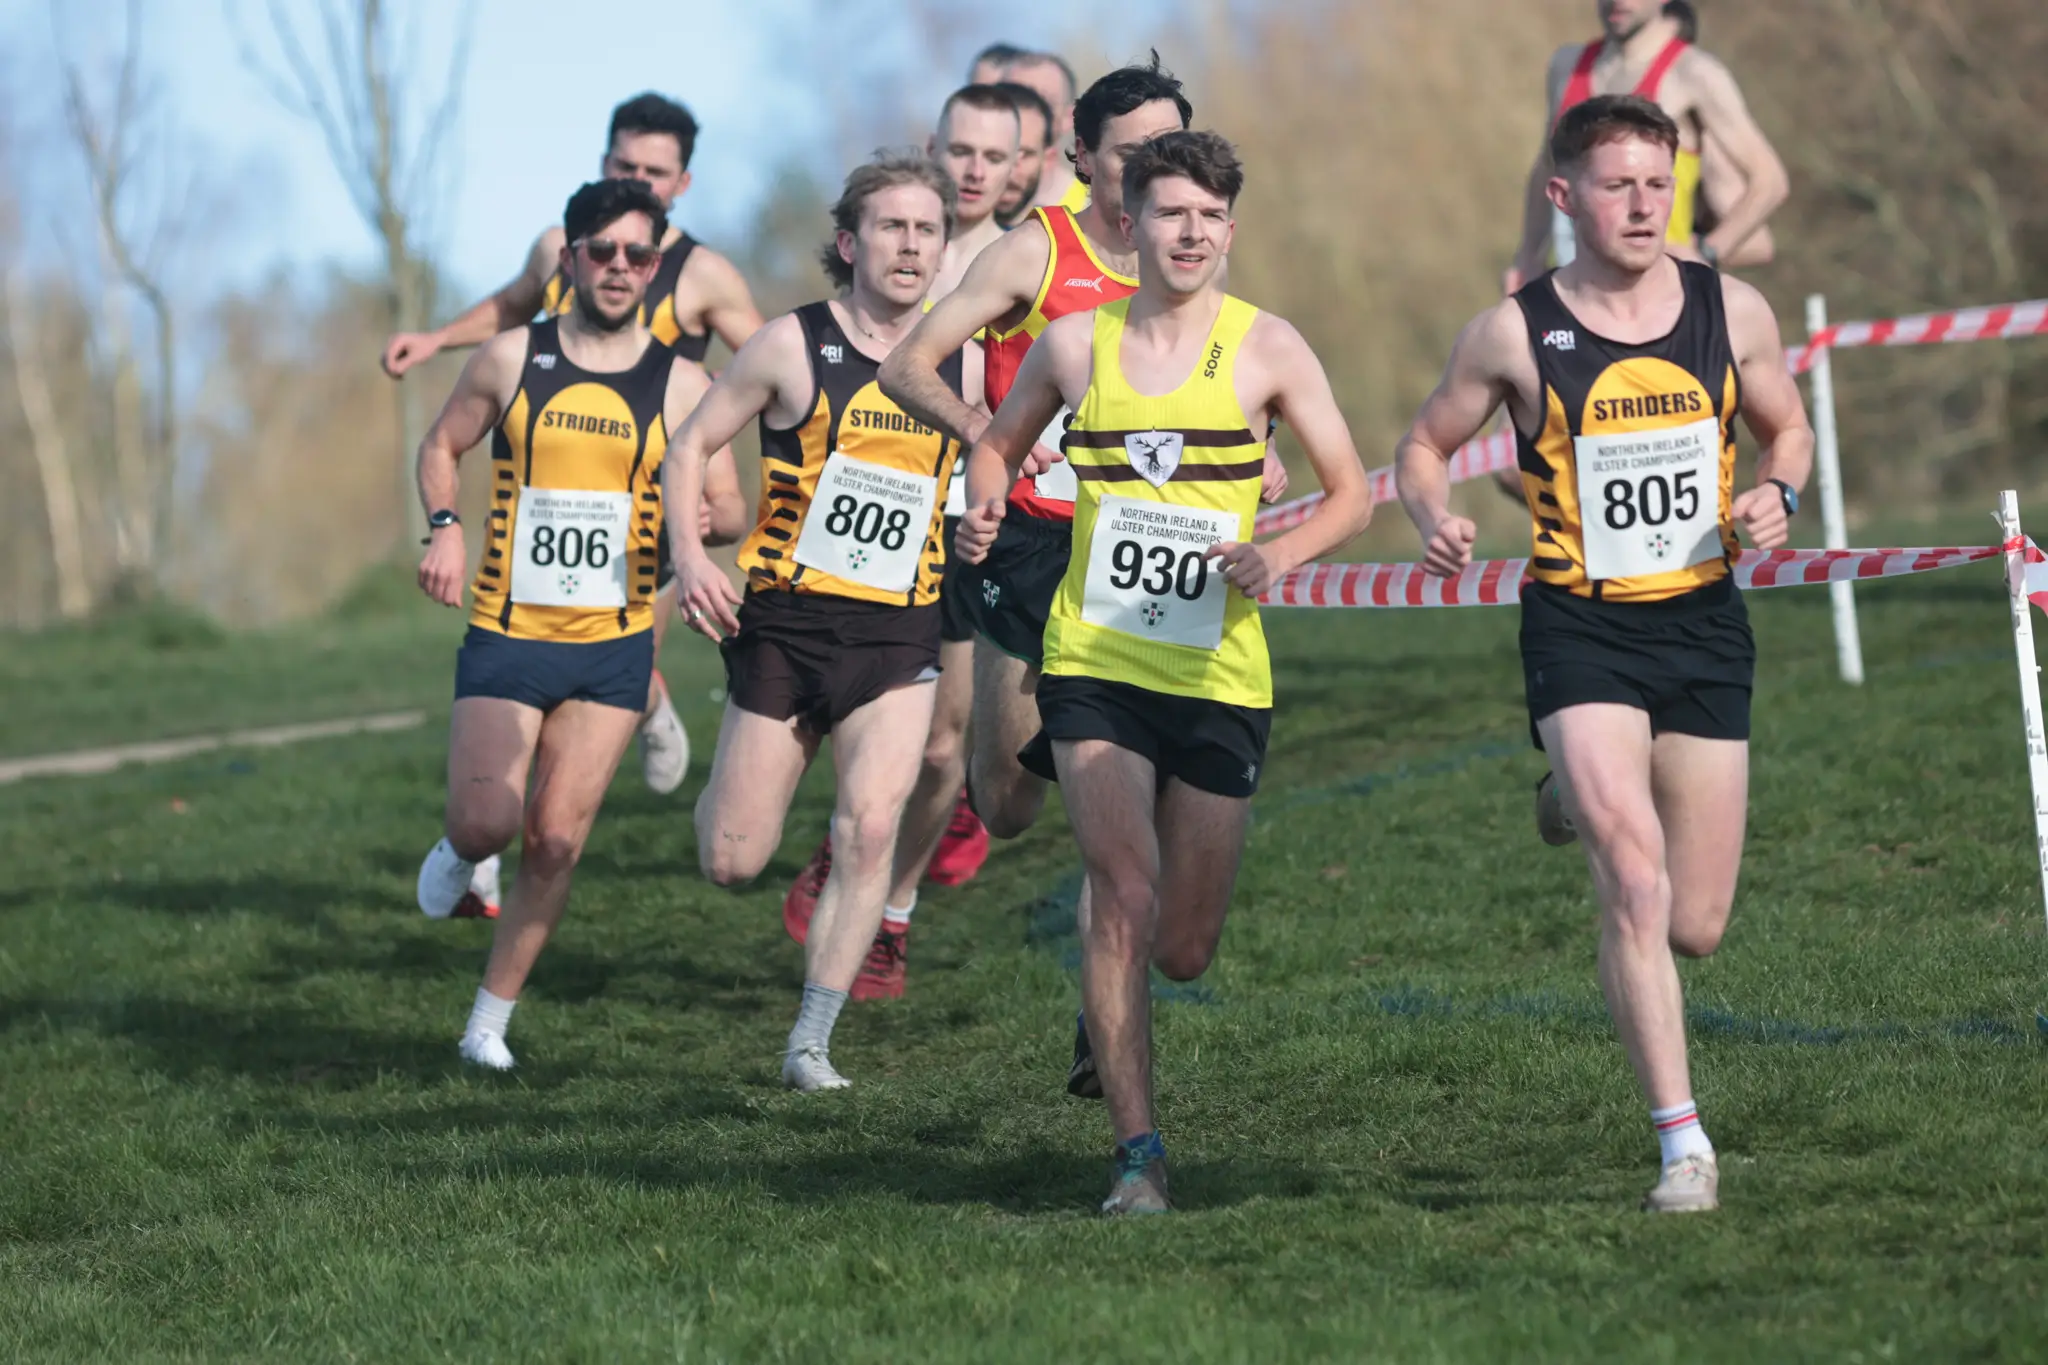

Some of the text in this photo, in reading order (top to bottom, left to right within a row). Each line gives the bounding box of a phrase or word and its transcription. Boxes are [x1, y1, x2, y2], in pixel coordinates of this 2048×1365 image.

[1204, 341, 1224, 379] soar
[1593, 390, 1702, 421] STRIDERS
[543, 410, 631, 440] STRIDERS
[1592, 446, 1706, 472] ULSTER CHAMPIONSHIPS
[1598, 443, 1650, 457] NORTHERN
[1652, 437, 1692, 451] IRELAND
[834, 475, 924, 507] ULSTER CHAMPIONSHIPS
[842, 466, 883, 484] NORTHERN
[885, 476, 916, 492] IRELAND
[1603, 468, 1699, 530] 805
[825, 494, 911, 551] 808
[1111, 519, 1221, 545] ULSTER CHAMPIONSHIPS
[1120, 507, 1217, 532] NORTHERN IRELAND &
[530, 526, 609, 569] 806
[1109, 540, 1208, 601] 930
